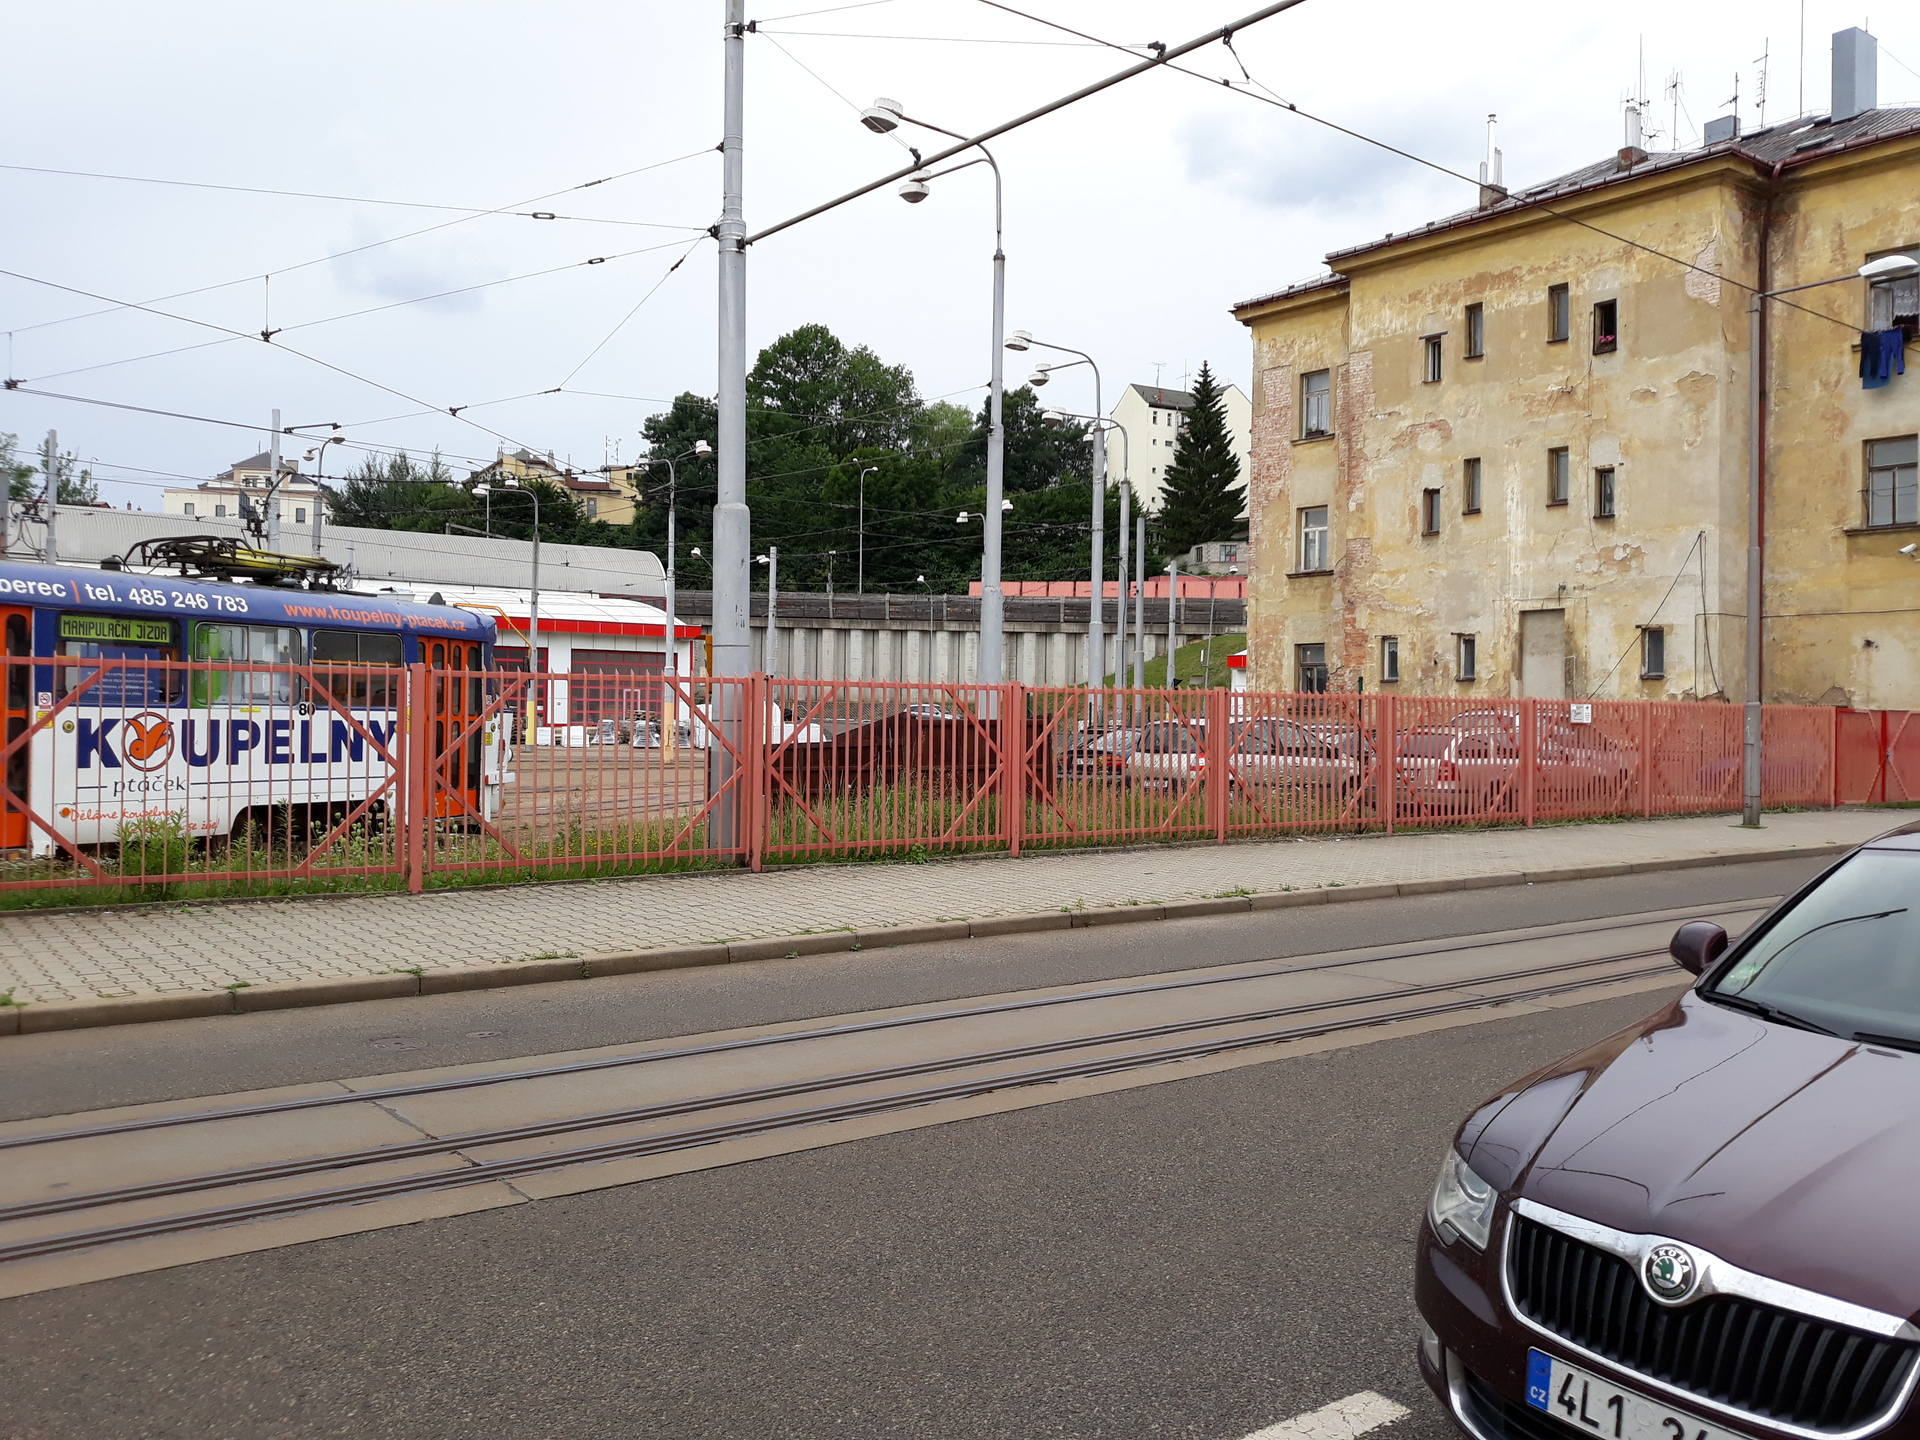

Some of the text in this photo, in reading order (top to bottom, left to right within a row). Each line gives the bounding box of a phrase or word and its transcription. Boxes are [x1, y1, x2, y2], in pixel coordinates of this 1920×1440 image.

[85, 583, 122, 602] tel.
[128, 588, 167, 607] 485
[171, 591, 209, 610] 246
[212, 594, 249, 612] 783
[283, 604, 467, 631] www.koupelny-ptacek.cz
[63, 620, 167, 640] MANIPULAČNÍ JÍZDA
[113, 775, 187, 797] ptáček
[1530, 1385, 1547, 1403] CZ
[1557, 1372, 1708, 1440] 4L1 3
